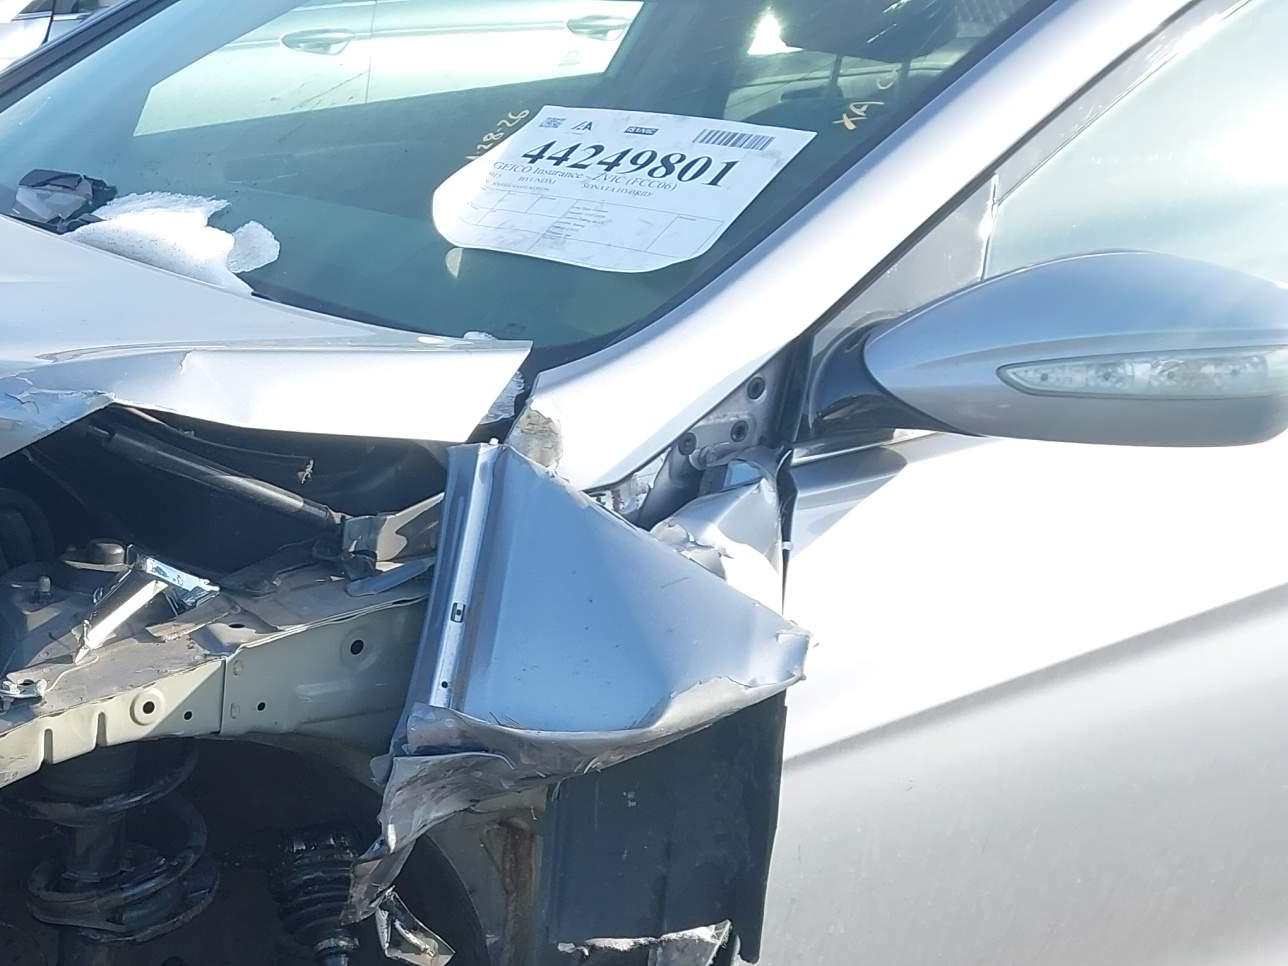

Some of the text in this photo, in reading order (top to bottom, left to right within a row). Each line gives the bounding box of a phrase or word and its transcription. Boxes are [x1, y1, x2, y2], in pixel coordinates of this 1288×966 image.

[493, 161, 532, 173] GEICO
[532, 167, 584, 179] Insurance
[521, 140, 740, 187] 44249801
